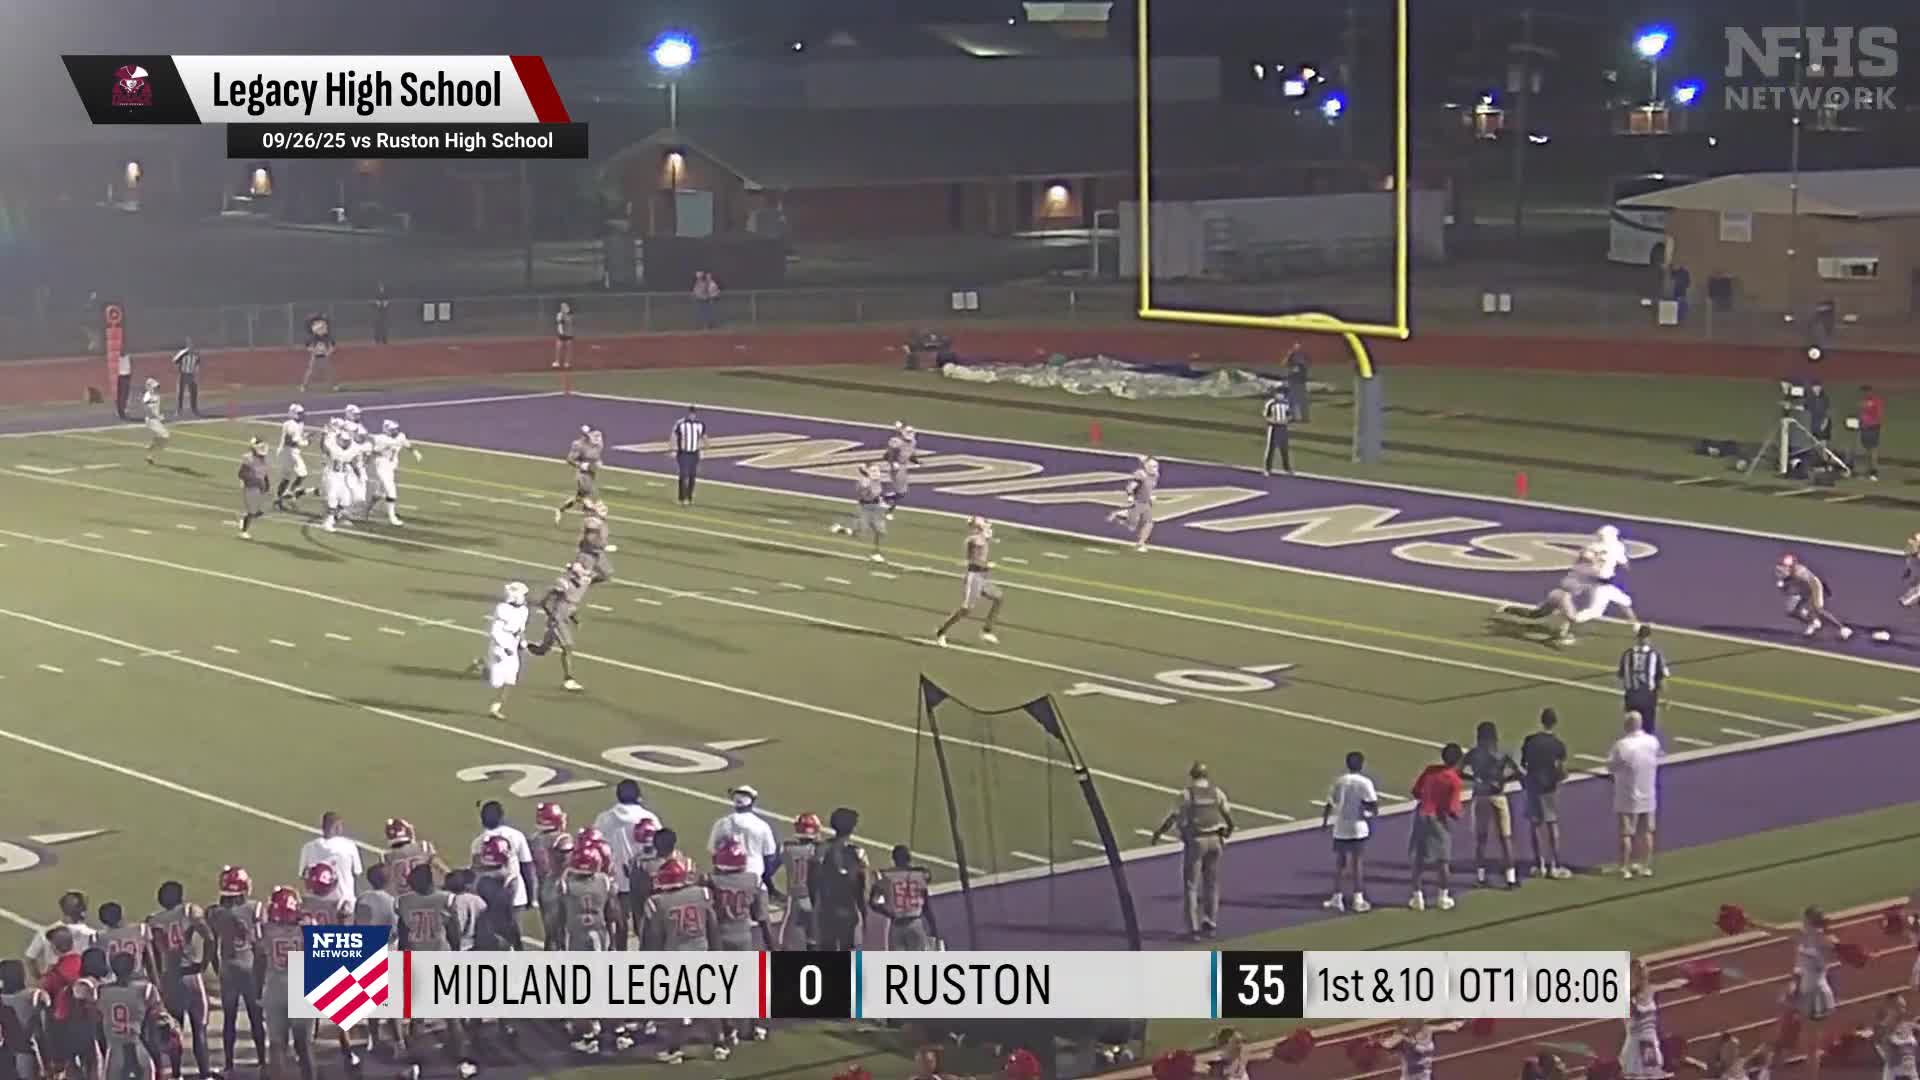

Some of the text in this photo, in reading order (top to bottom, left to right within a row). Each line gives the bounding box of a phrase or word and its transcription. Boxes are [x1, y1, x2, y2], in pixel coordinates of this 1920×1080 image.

[612, 431, 1658, 572] INDIANS
[1064, 669, 1277, 705] 10
[456, 745, 729, 797] 20
